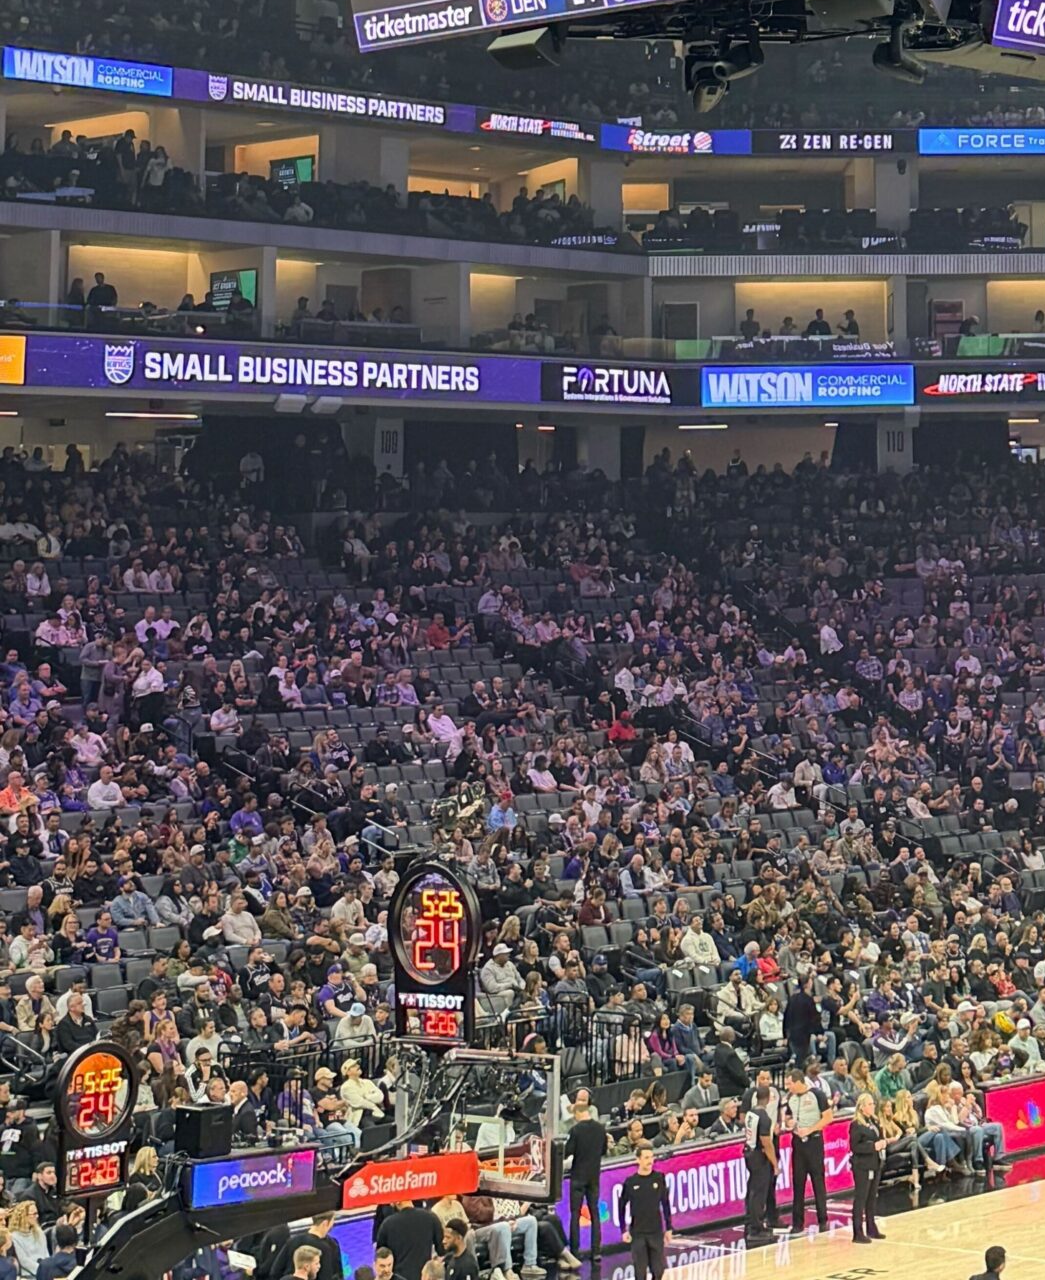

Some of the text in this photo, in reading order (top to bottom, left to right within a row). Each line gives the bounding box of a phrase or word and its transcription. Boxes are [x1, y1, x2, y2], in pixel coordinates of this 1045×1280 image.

[364, 3, 473, 39] ticketmaster
[14, 50, 94, 86] WATSON
[98, 64, 164, 82] COMMERCIAL
[97, 76, 144, 89] ROOFING
[233, 81, 444, 124] SMALL BUSINESS PARTNERS
[629, 129, 690, 146] iStreet
[804, 135, 831, 149] ZEN
[958, 134, 1024, 148] FORCE
[145, 352, 479, 392] SMALL BUSINESS PARTNERS
[563, 367, 671, 395] FORTUNA
[818, 375, 906, 385] COMMERCIAL
[938, 373, 1024, 393] NORTH STATE
[708, 372, 812, 402] WATSON
[818, 387, 880, 397] ROOFING
[422, 890, 463, 919] 5:25
[415, 919, 459, 970] 24
[425, 1011, 456, 1036] 2:26
[84, 1069, 122, 1094] 5:25
[79, 1094, 113, 1128] 24
[80, 1157, 119, 1187] 2:26
[219, 1163, 287, 1199] peacock
[677, 1163, 726, 1211] COAST
